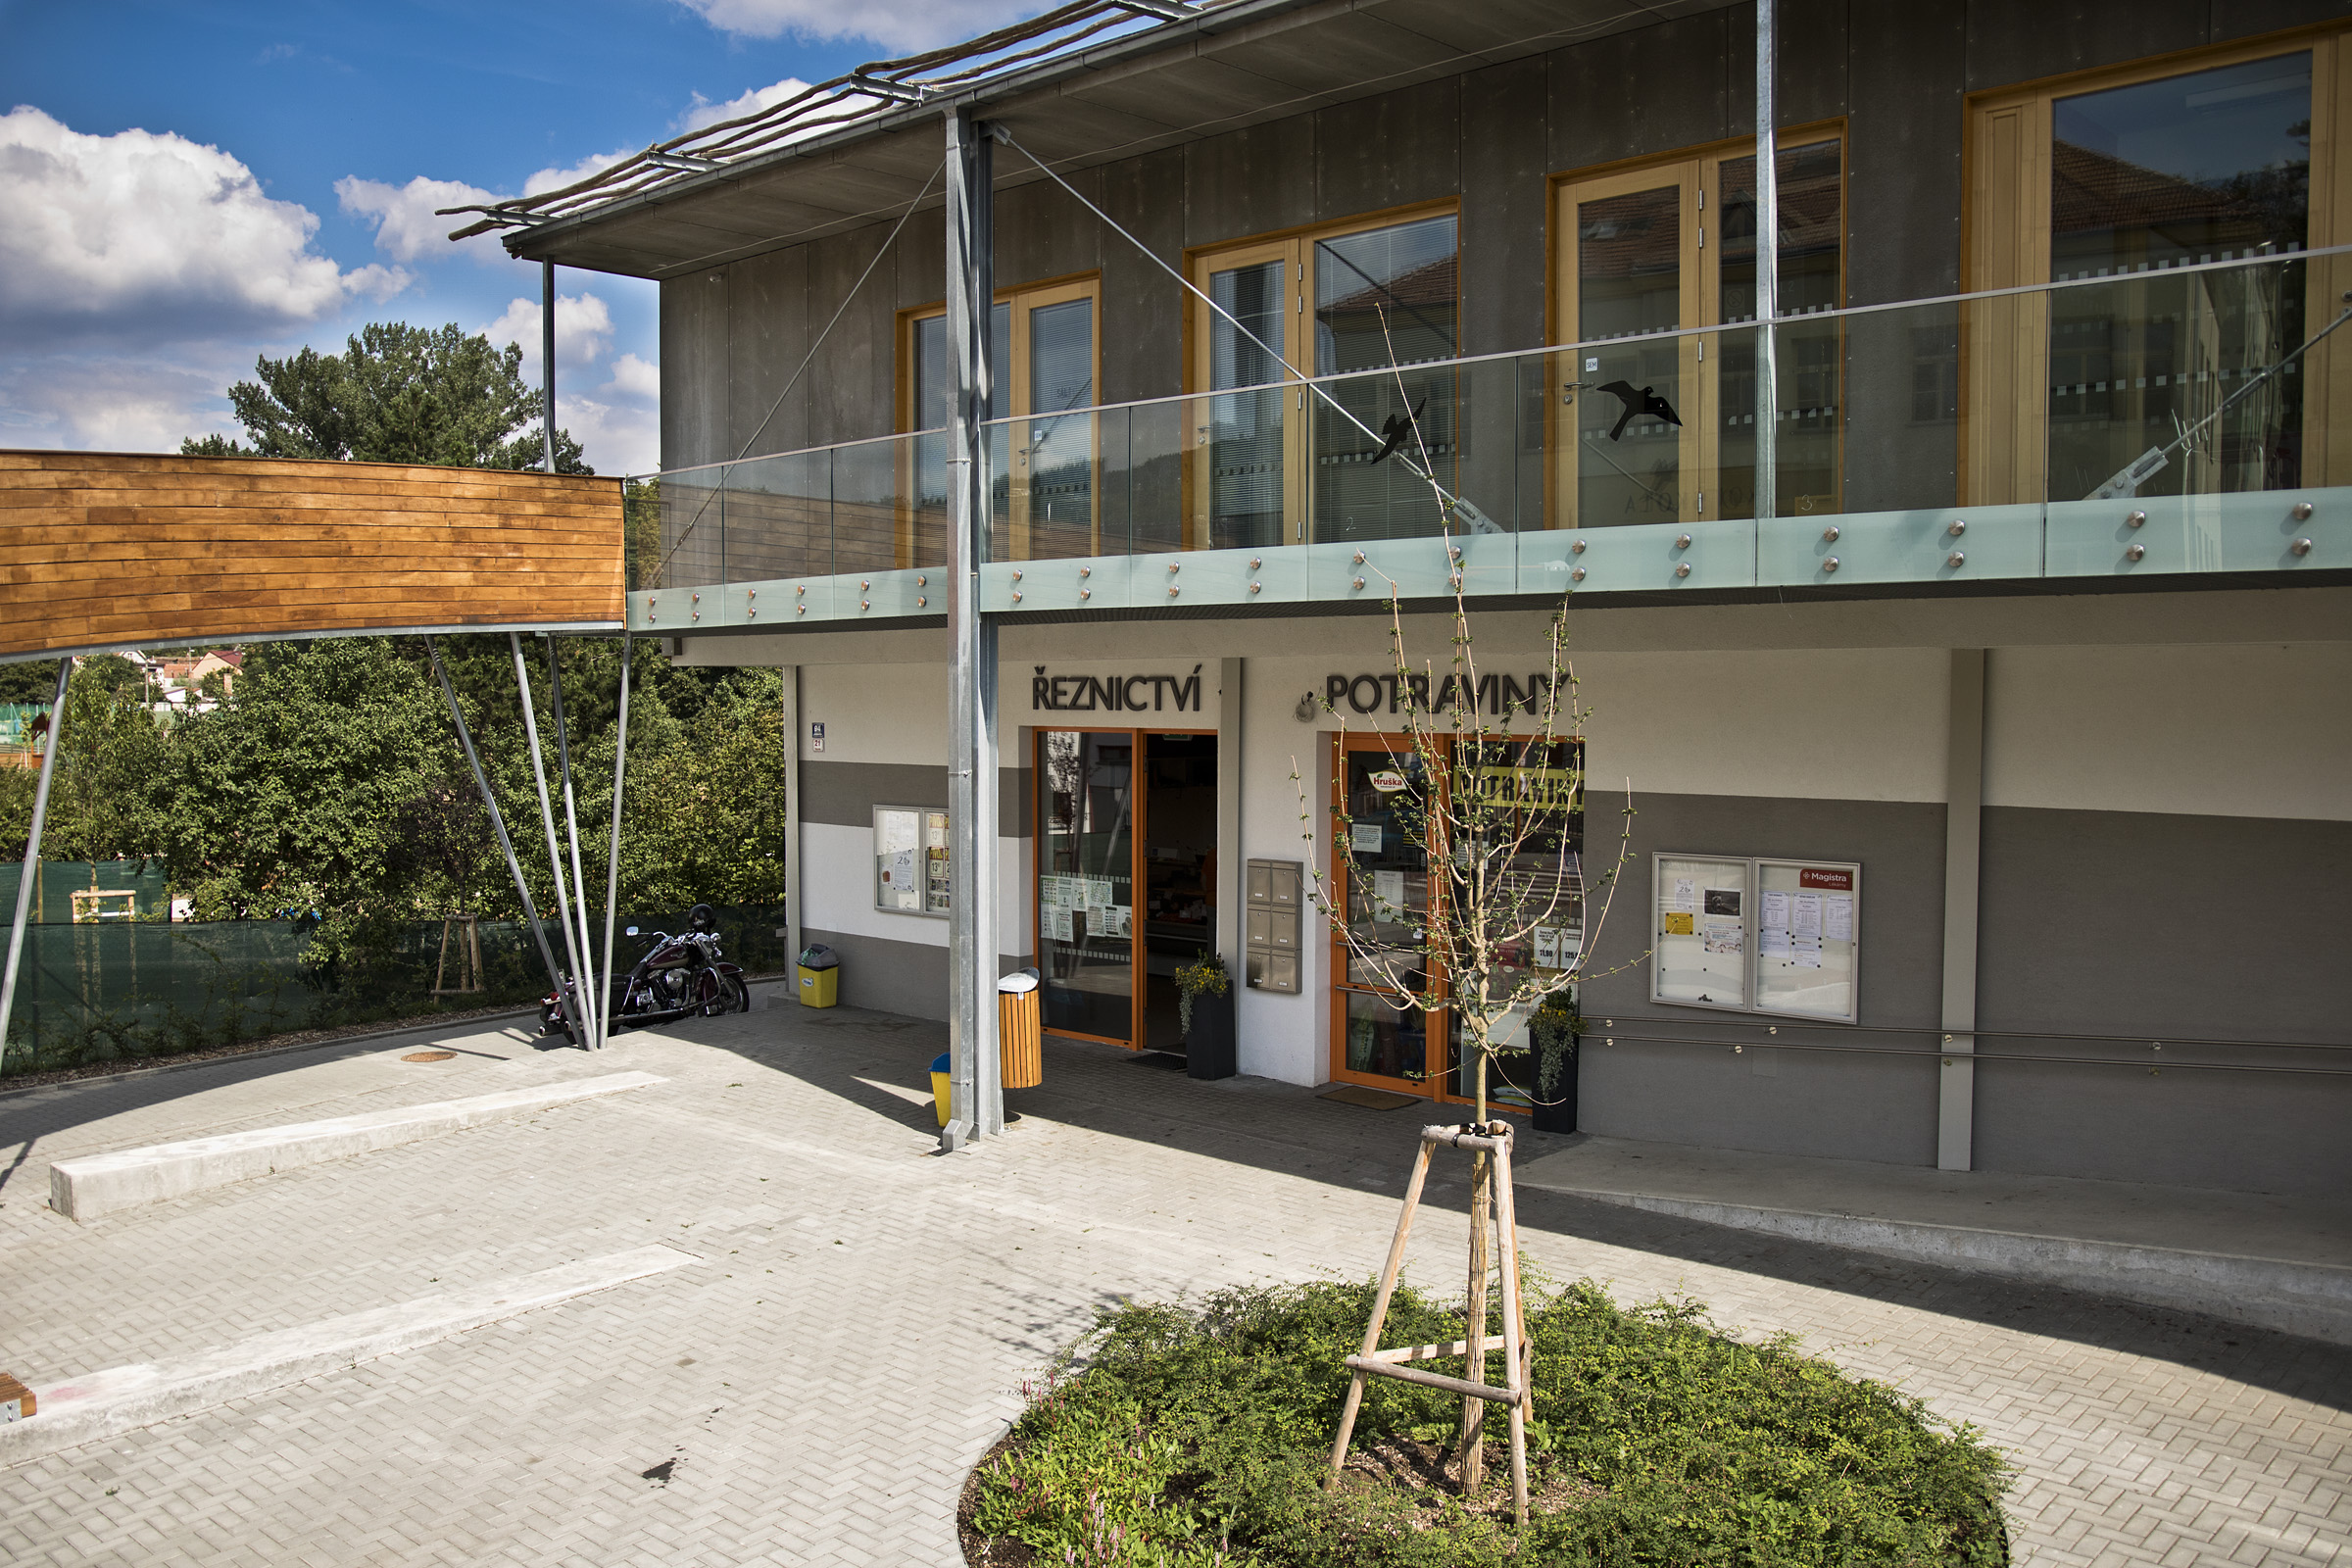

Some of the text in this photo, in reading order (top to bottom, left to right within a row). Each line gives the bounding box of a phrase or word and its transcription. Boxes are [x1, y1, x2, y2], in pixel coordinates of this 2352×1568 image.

[1032, 663, 1202, 712] ŘEZNICTVÍ
[1326, 673, 1571, 716] POTRAVINY
[1373, 777, 1402, 786] Hruška
[1811, 872, 1847, 883] Magistra
